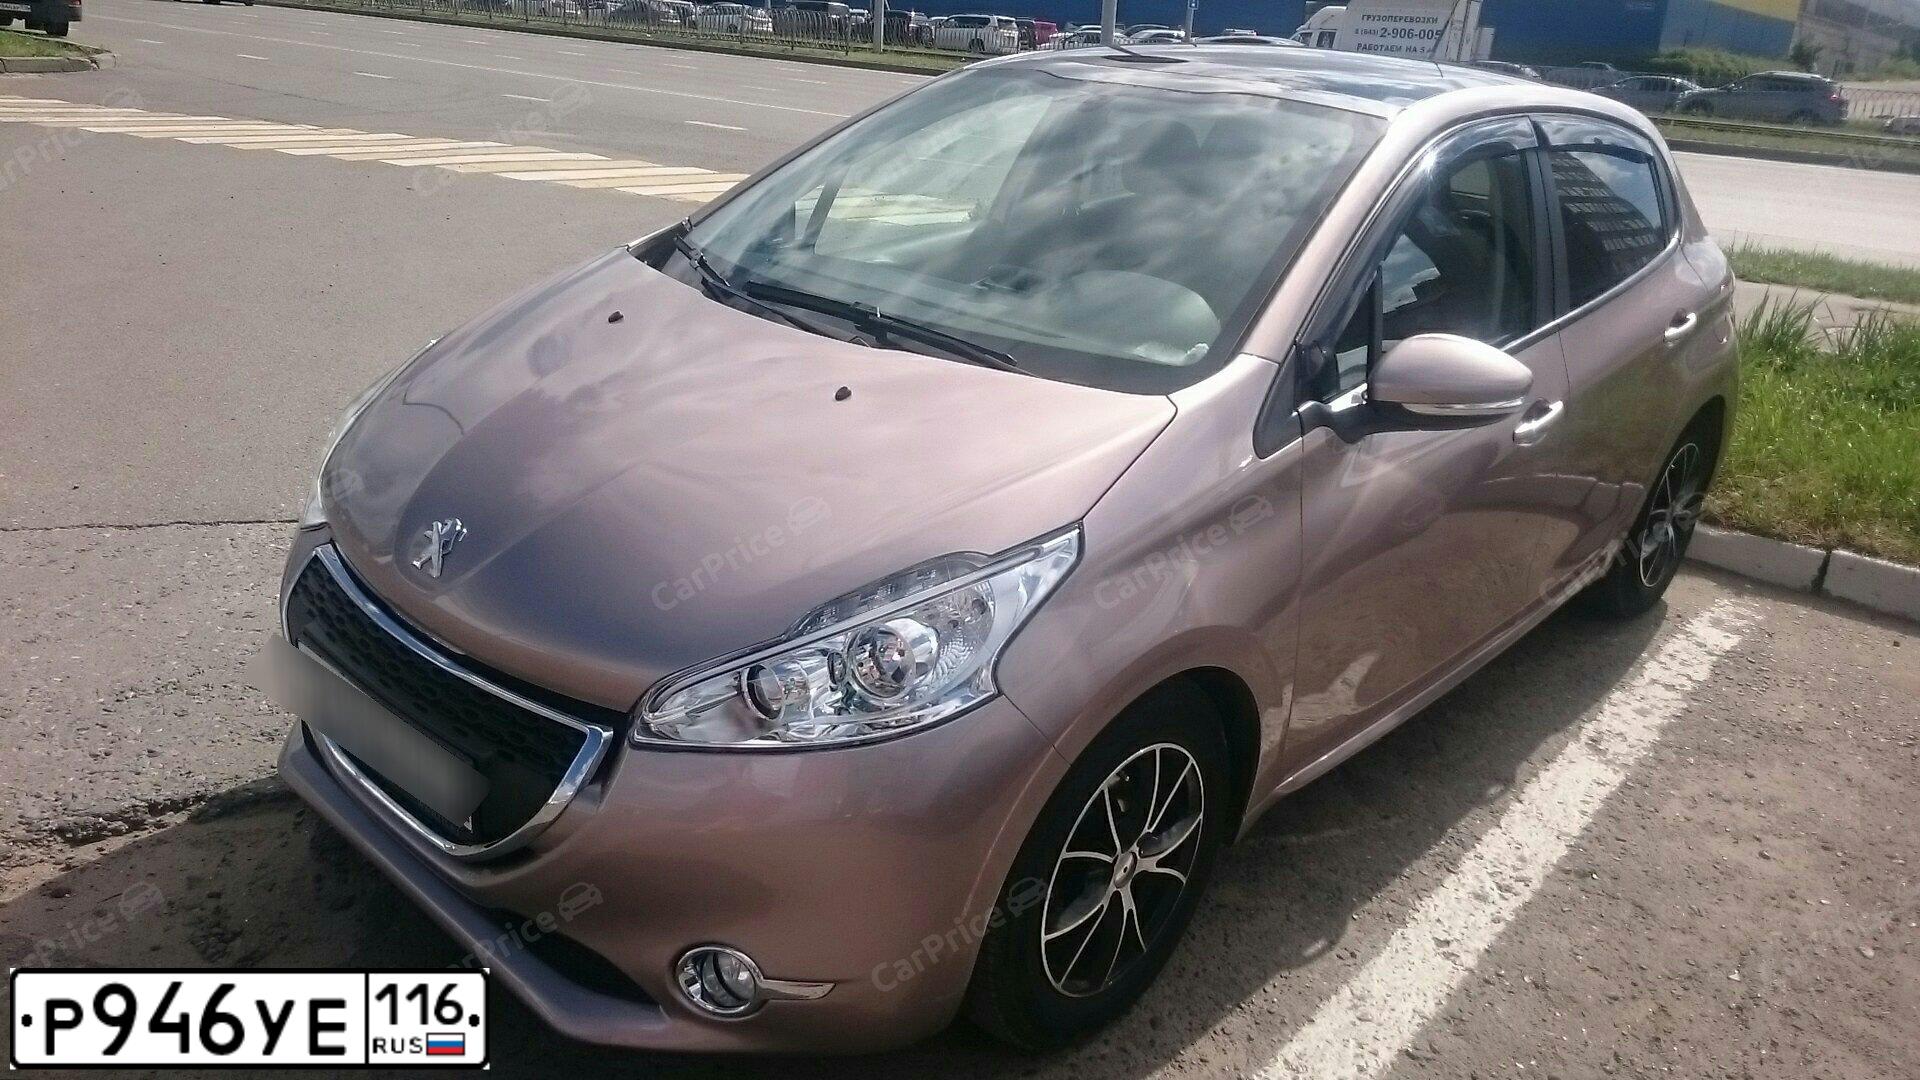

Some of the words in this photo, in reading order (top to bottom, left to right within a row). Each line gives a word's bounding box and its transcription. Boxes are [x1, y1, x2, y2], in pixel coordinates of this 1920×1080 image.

[1361, 14, 1439, 24] ГРУЗОПЕРЕВОЗКИ
[1379, 26, 1441, 41] 2-906-005
[1356, 42, 1402, 53] РАБОТАЕМ
[1405, 45, 1417, 53] НА
